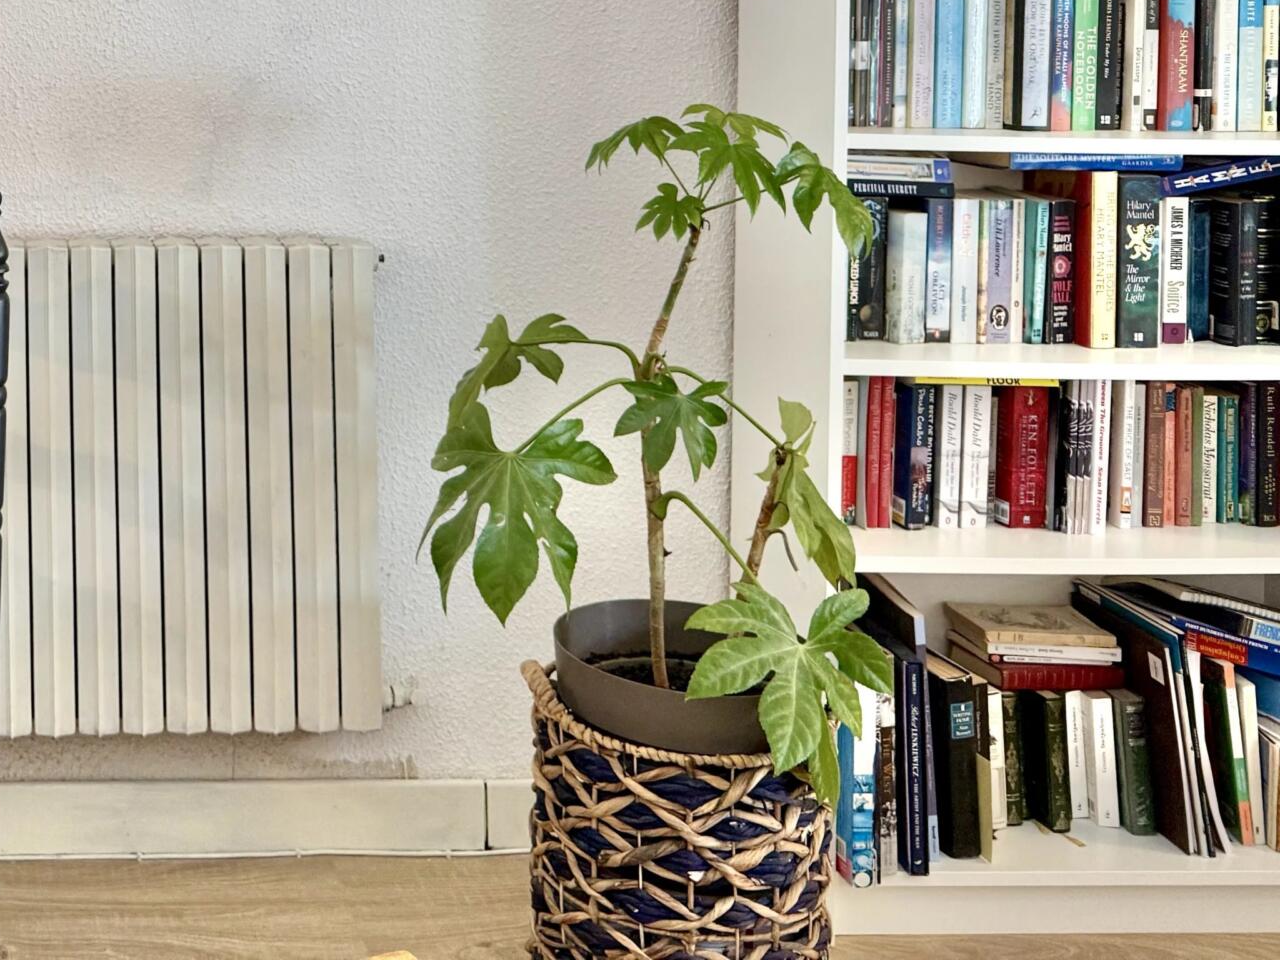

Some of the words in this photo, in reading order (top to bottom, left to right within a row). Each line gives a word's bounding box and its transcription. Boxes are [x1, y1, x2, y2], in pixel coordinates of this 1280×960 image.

[993, 0, 1001, 26] JOHN
[1063, 40, 1068, 49] OF
[1087, 26, 1097, 50] THE
[1075, 31, 1086, 104] NOTEBOOK
[1178, 30, 1188, 93] SHANTARAM
[1086, 55, 1096, 109] GOLDEN
[854, 183, 885, 193] PERCIVAL
[888, 185, 917, 194] EVERETT
[1127, 201, 1151, 210] Hilary
[1127, 210, 1154, 219] Mantel
[1171, 206, 1183, 228] JAMES
[1170, 239, 1183, 270] MICHENER
[1096, 251, 1104, 296] MANTEL
[1126, 264, 1139, 273] The
[1126, 275, 1150, 283] Mirror
[850, 280, 859, 304] LUNCH
[1106, 273, 1114, 312] BODIES
[1125, 284, 1131, 292] &
[1133, 284, 1145, 292] the
[1125, 294, 1145, 303] Light
[1167, 281, 1184, 313] Source
[948, 392, 957, 419] Roald
[973, 393, 982, 421] Roald
[1267, 386, 1276, 412] Ruth
[947, 422, 956, 446] Dahl
[972, 423, 982, 447] Dahl
[1028, 414, 1038, 441] KEN
[1204, 400, 1215, 444] Nicholas
[1267, 417, 1275, 457] Rendell
[1126, 448, 1132, 458] OF
[1026, 448, 1037, 506] FOLLETT
[1204, 446, 1215, 500] Monsarrat
[882, 737, 890, 758] THE
[911, 728, 919, 777] LENKIEWICZ
[882, 763, 892, 794] WEST
